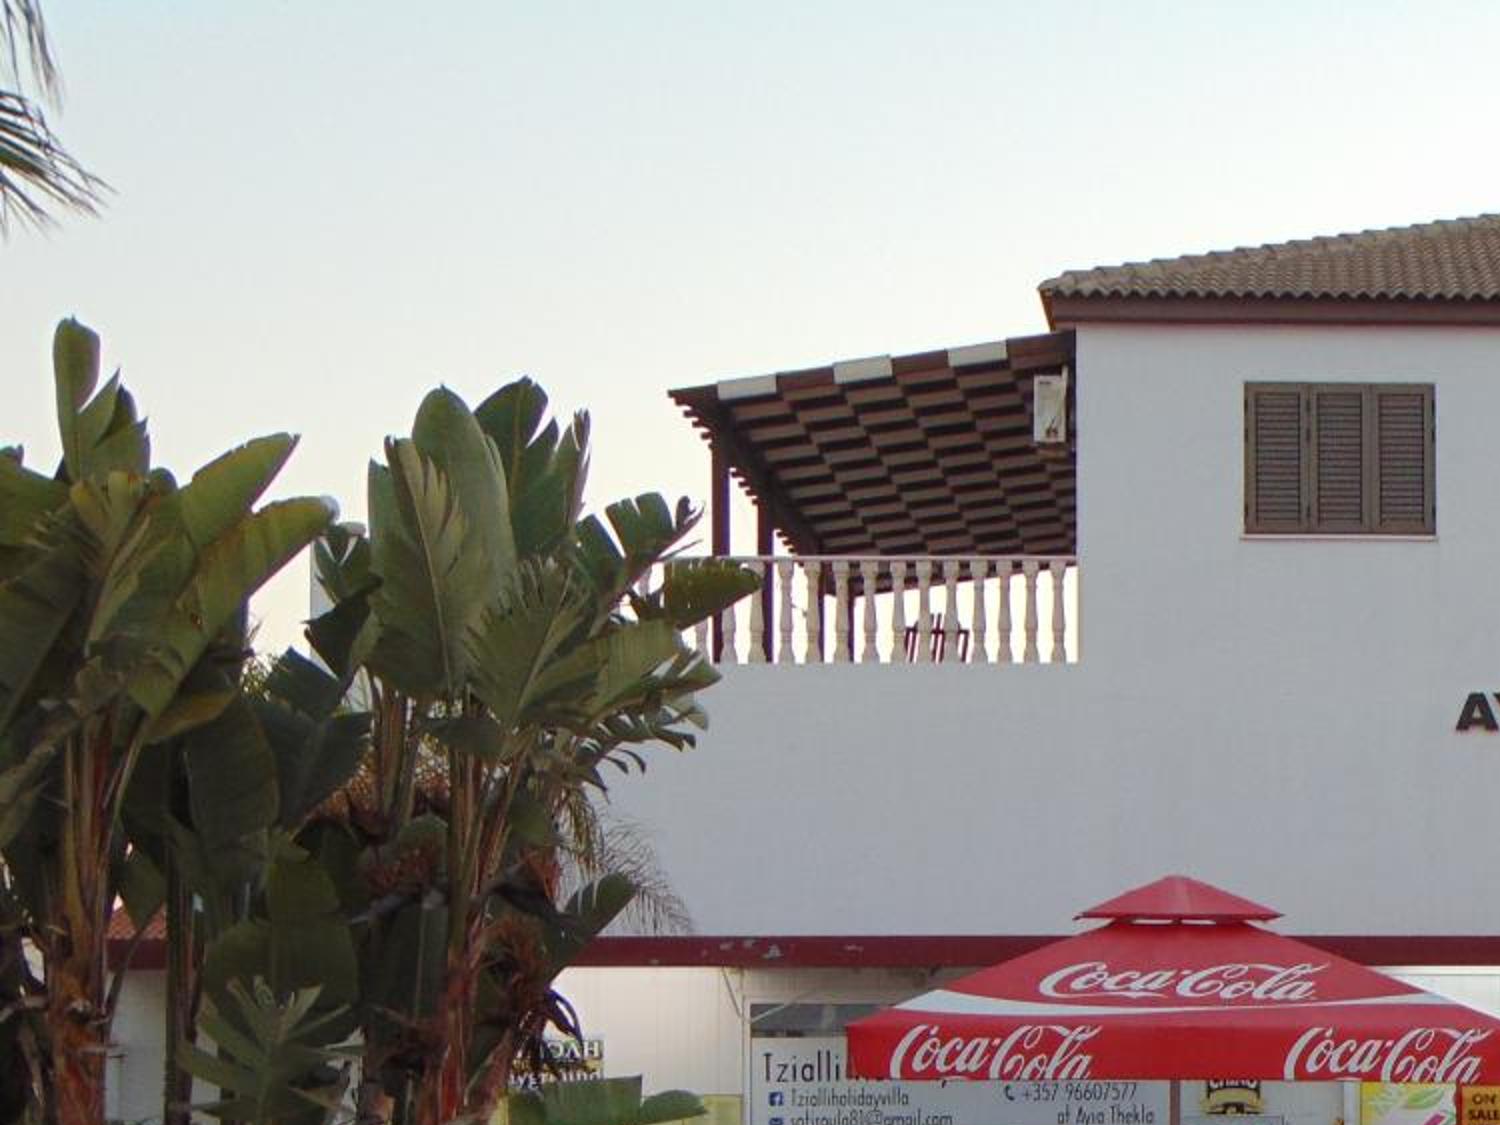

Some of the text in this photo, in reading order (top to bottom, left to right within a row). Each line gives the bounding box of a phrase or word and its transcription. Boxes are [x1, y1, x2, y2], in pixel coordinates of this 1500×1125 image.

[763, 1050, 840, 1083] Tzialli
[1472, 1093, 1496, 1104] ON
[1468, 1109, 1500, 1120] SALE
